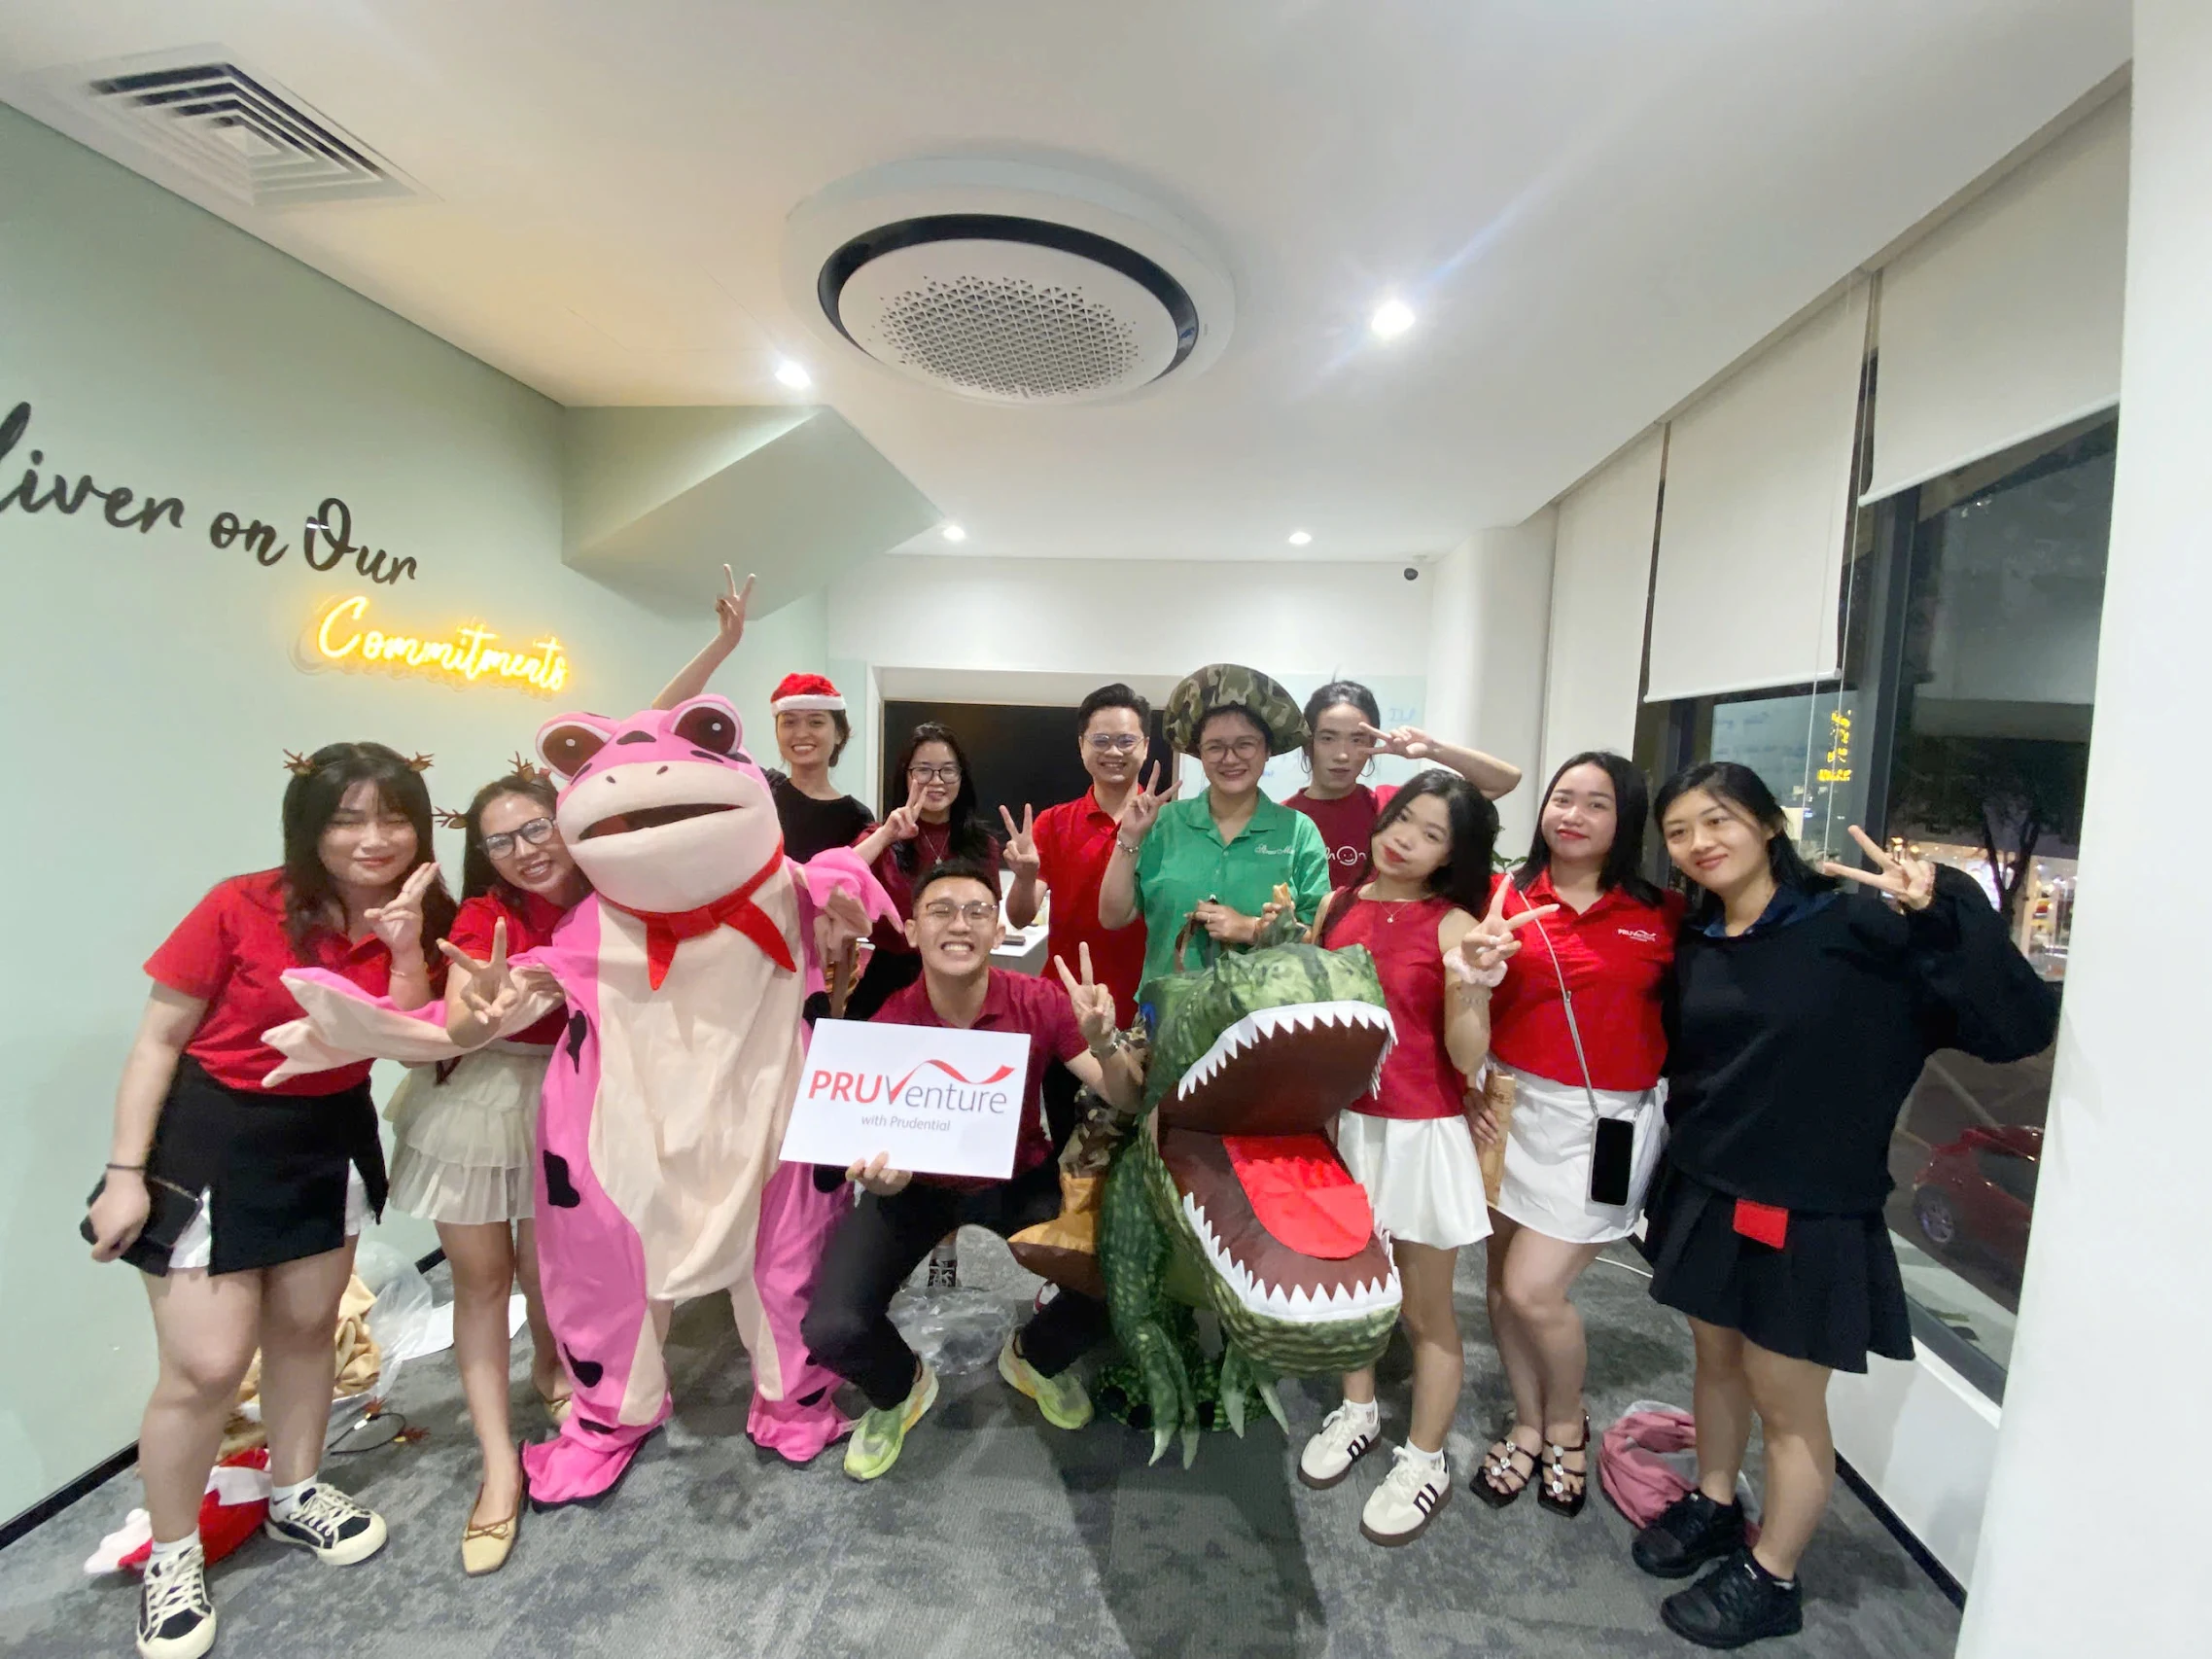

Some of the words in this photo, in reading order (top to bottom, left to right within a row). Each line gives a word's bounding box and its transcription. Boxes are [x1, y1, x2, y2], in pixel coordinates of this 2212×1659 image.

[210, 512, 289, 566] on
[303, 497, 417, 584] Our
[316, 594, 569, 691] Commitments
[808, 1059, 1016, 1113] PRUVenture
[861, 1115, 887, 1127] with
[891, 1115, 951, 1131] Prudential
